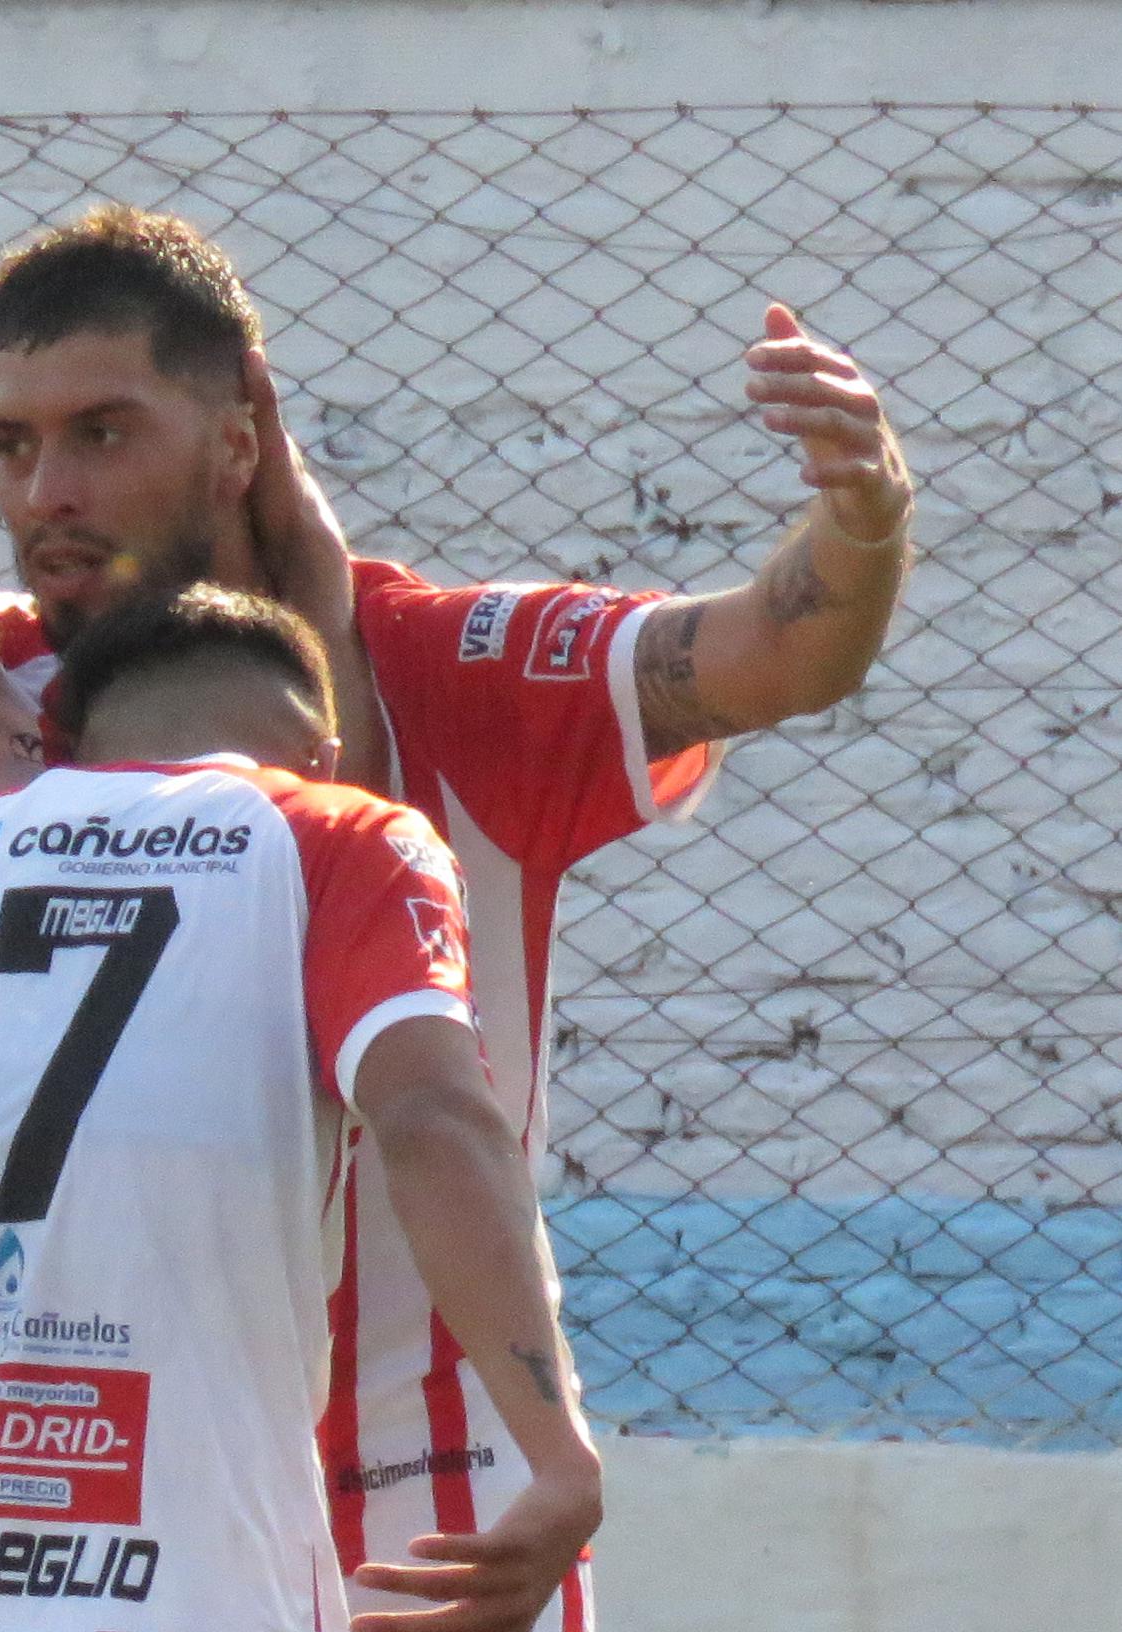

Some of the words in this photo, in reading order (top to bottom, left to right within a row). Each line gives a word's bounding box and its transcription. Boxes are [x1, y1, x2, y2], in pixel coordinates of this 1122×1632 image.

[9, 815, 252, 858] cañuelas
[58, 860, 150, 875] GOBIERNO
[154, 860, 239, 875] MUNICIPAL
[5, 1384, 96, 1405] mayorista
[0, 1478, 68, 1497] PRECIO
